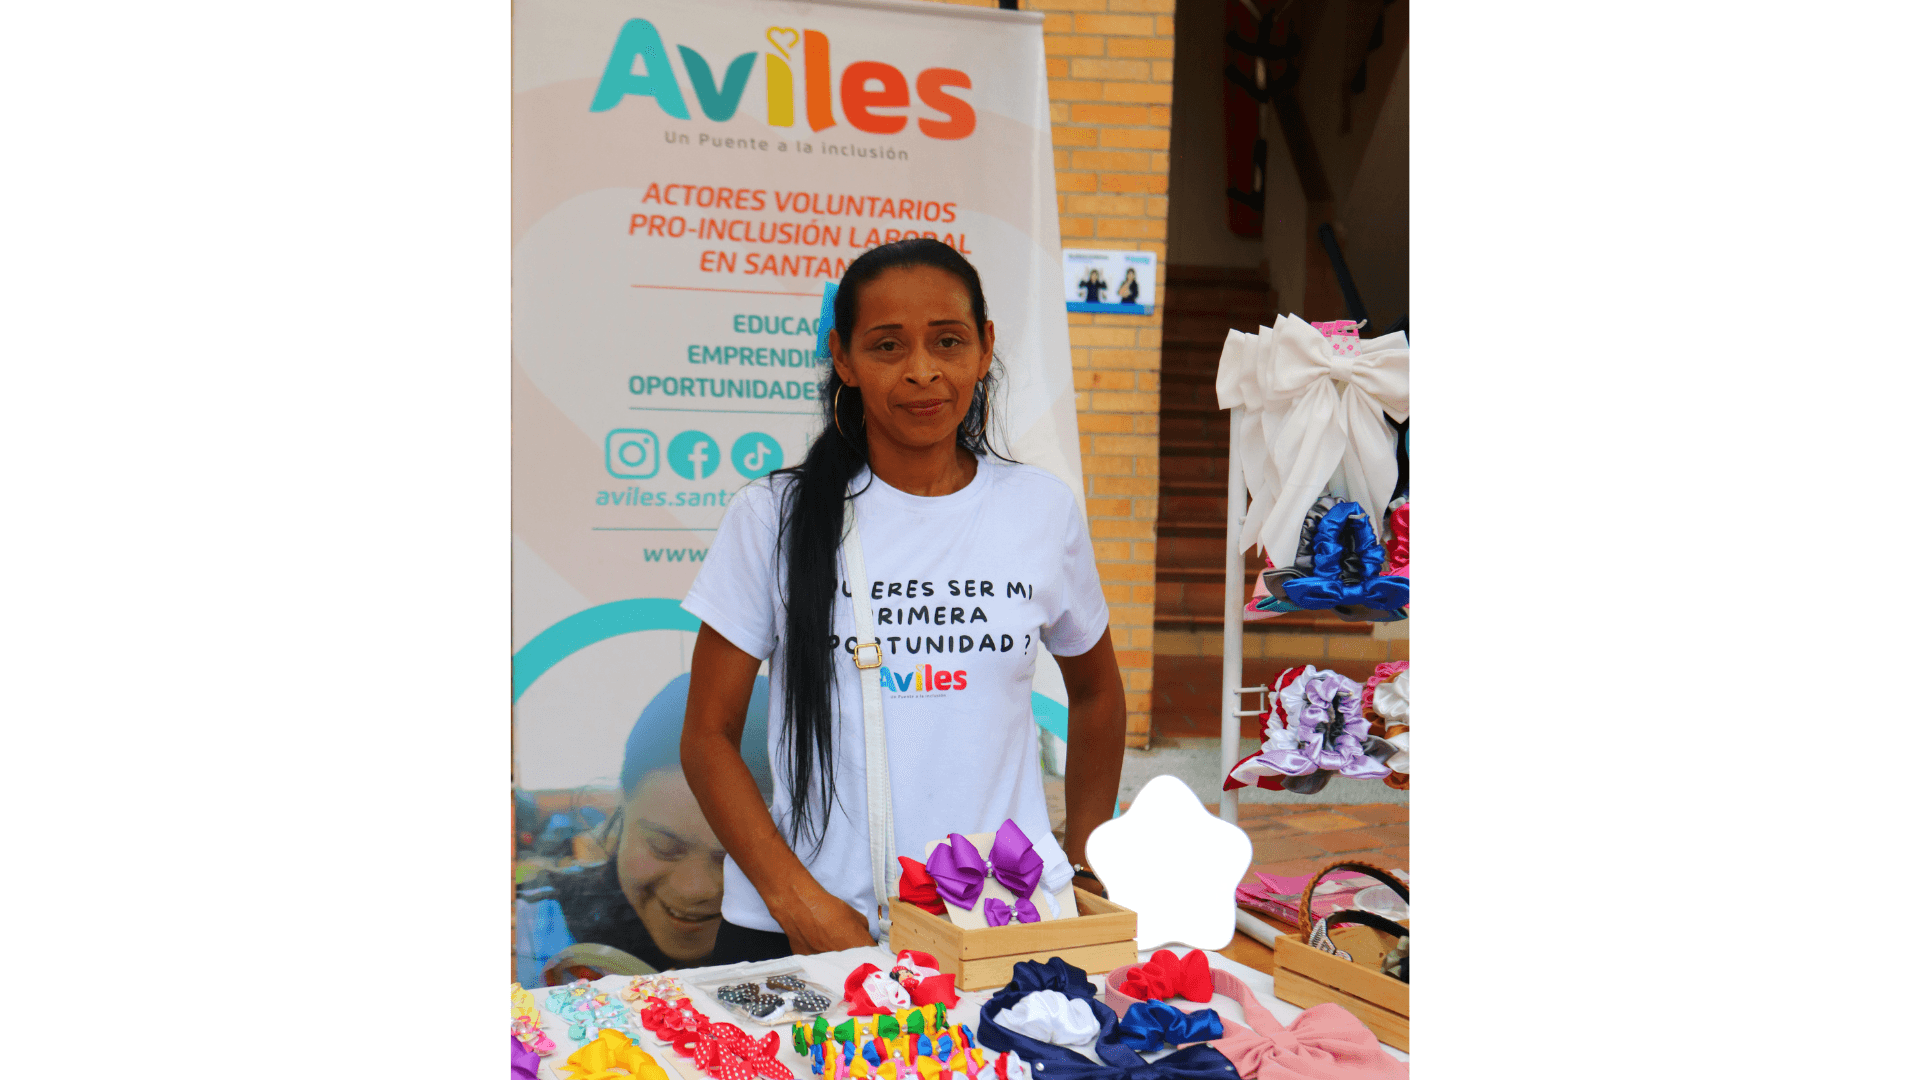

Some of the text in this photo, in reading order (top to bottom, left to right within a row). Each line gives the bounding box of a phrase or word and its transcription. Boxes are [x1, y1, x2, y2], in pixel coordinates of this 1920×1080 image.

[589, 18, 977, 140] Aviles
[664, 131, 909, 160] Un Puente a la inclusión
[641, 182, 957, 223] ACTORES VOLUNTARIOS
[628, 213, 842, 248] PRO-INCLUSIÓN
[699, 250, 854, 279] EN SANTAN
[628, 375, 820, 401] OPORTUNIDADE
[595, 486, 734, 507] aviles.sant
[948, 579, 995, 598] SER
[1006, 581, 1033, 601] MI
[872, 605, 988, 626] RIMERA
[880, 664, 967, 692] Aviles
